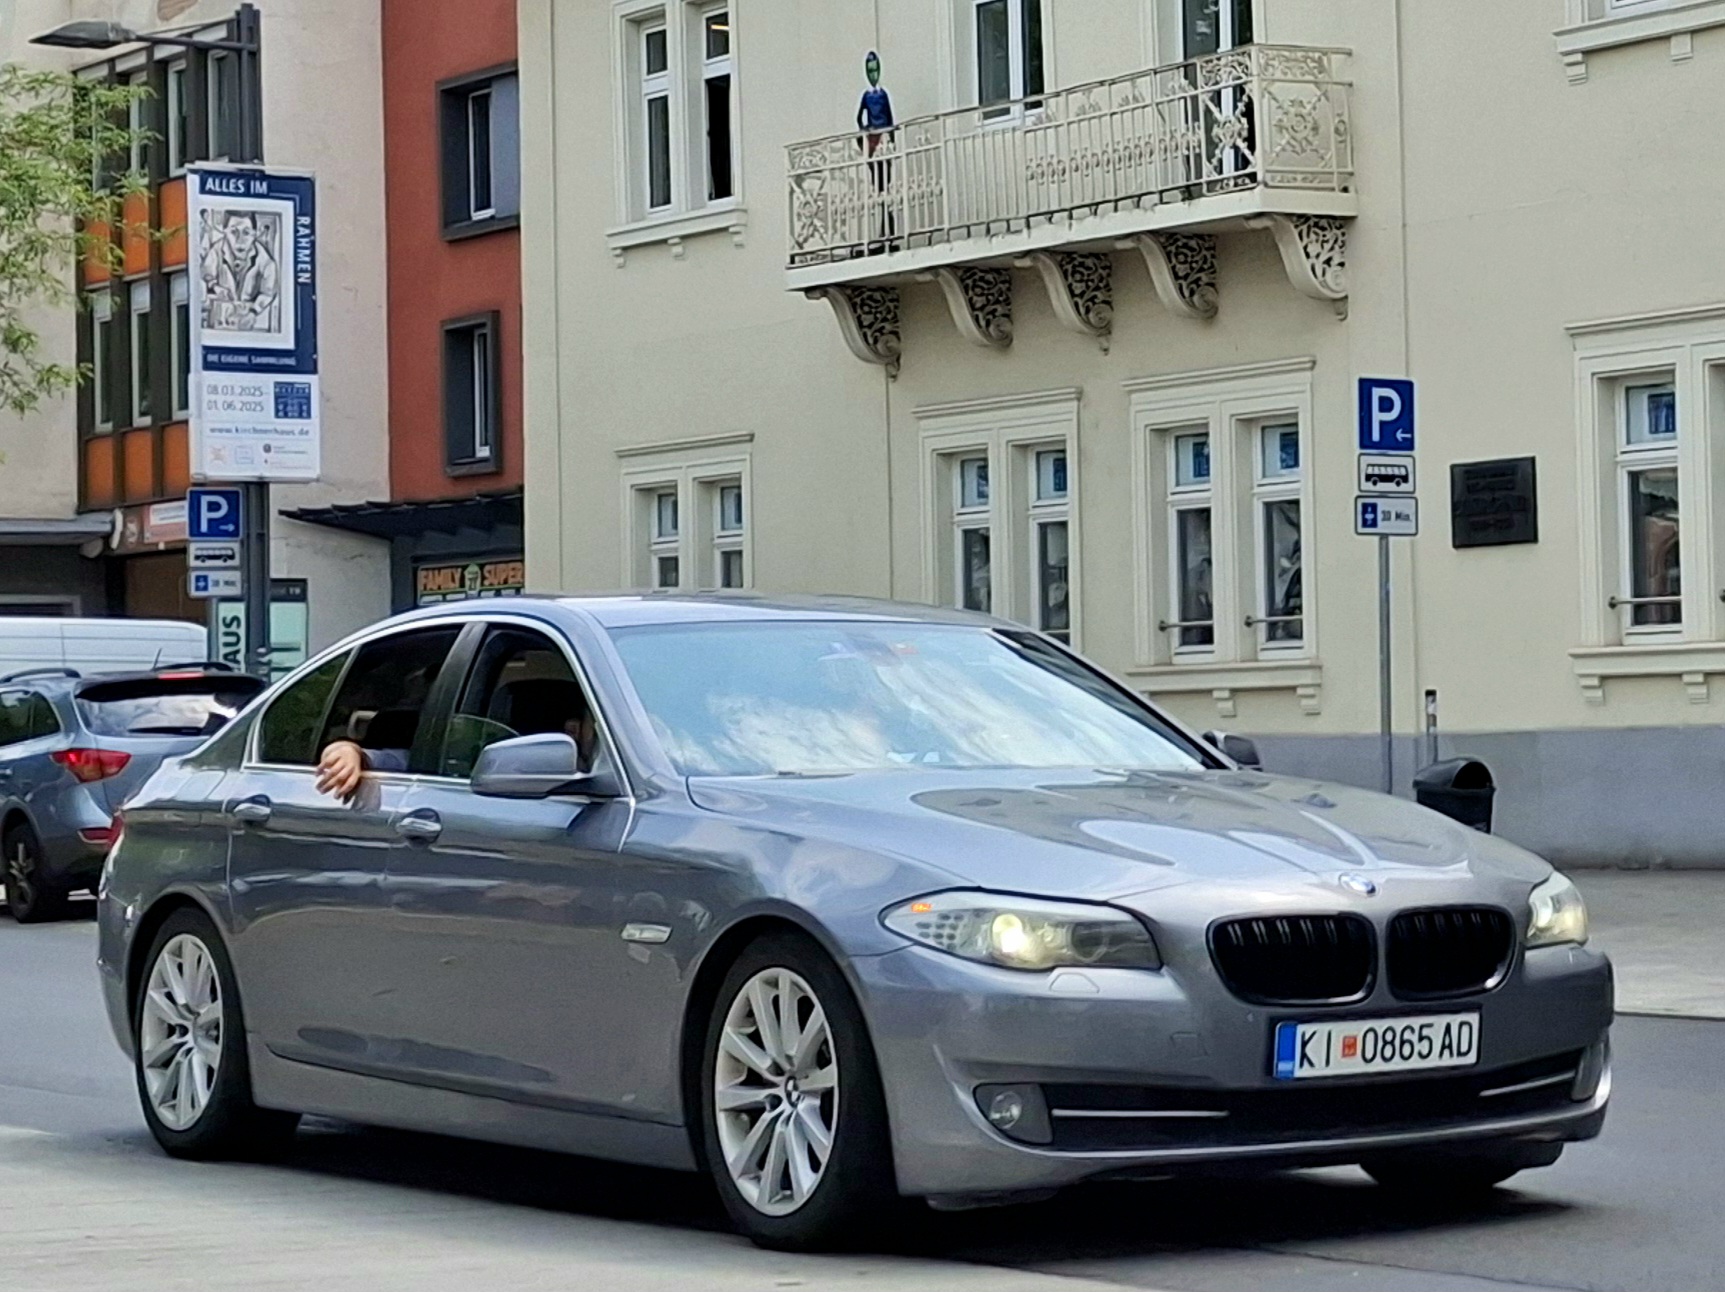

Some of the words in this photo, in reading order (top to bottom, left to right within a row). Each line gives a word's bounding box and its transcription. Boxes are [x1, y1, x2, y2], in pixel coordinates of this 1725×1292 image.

[205, 177, 245, 193] ALLES
[250, 180, 268, 195] IM
[296, 216, 312, 284] RAHMEN
[1371, 386, 1402, 442] P
[199, 495, 229, 533] P
[420, 567, 462, 591] FAMILY
[221, 614, 242, 673] AUS
[1299, 1029, 1332, 1069] KI
